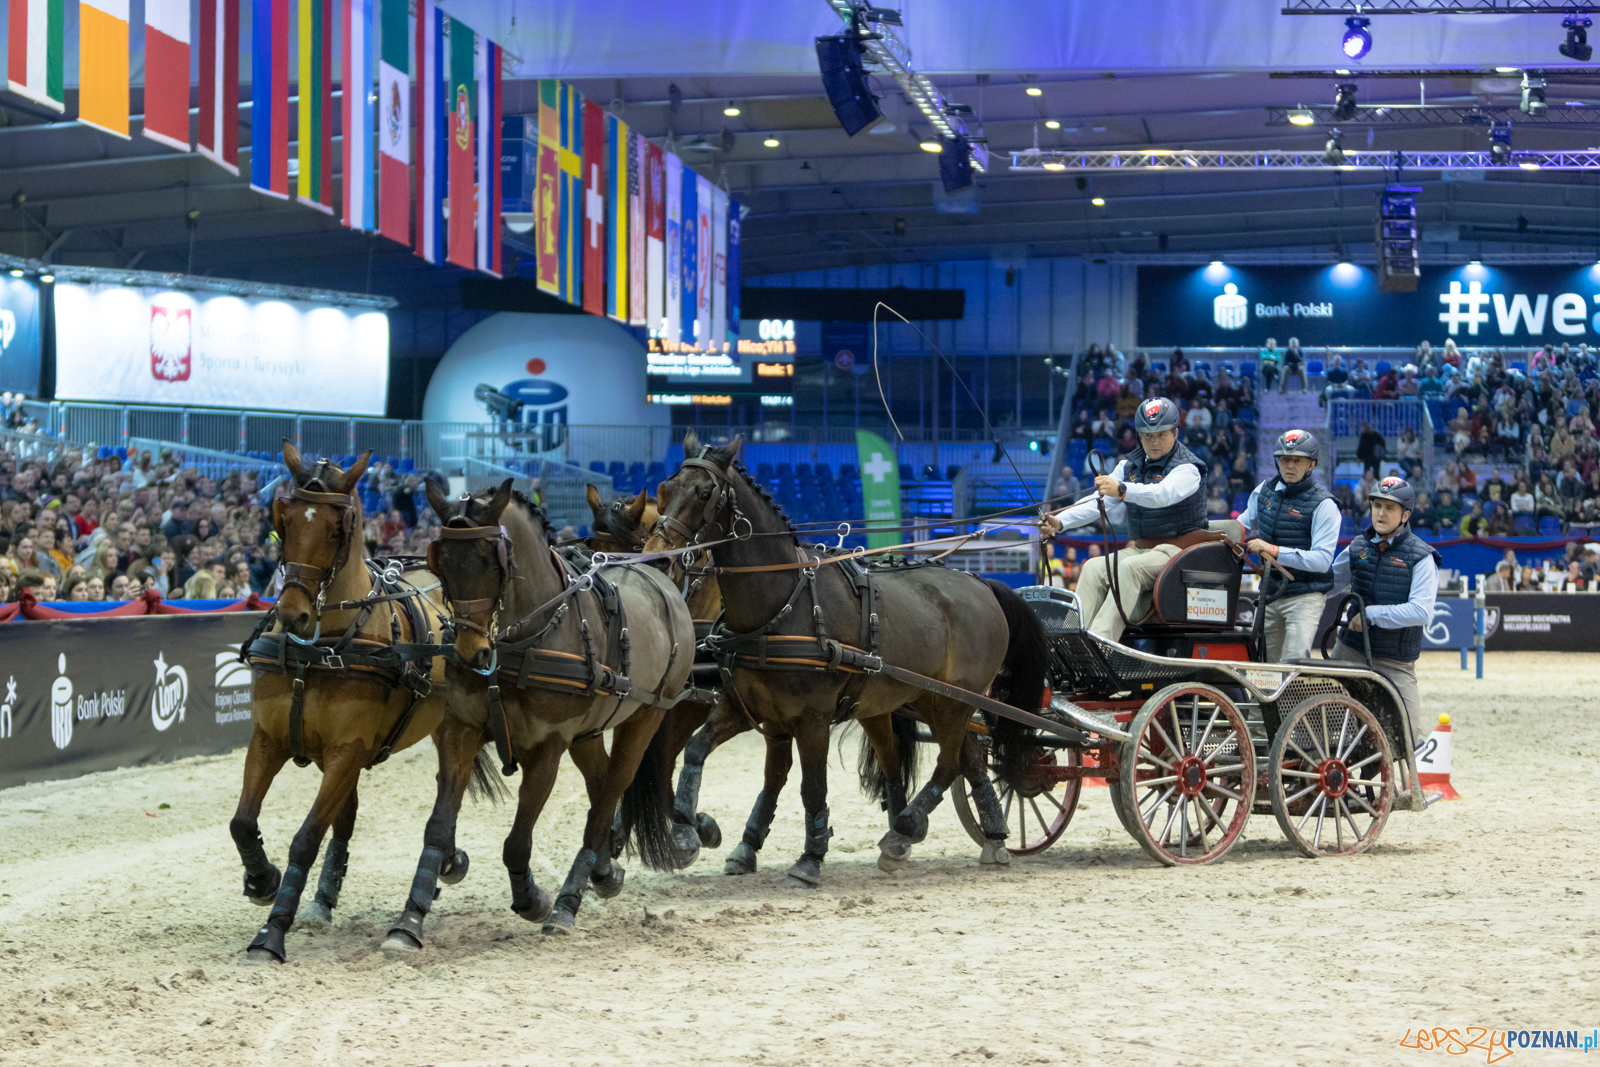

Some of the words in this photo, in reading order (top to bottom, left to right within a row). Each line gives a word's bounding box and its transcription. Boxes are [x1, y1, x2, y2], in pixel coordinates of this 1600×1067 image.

[1255, 303, 1290, 318] Bank
[1293, 302, 1333, 318] Polski
[759, 319, 795, 340] 004
[252, 355, 306, 378] Turystyki
[1187, 603, 1226, 617] equinox
[1254, 677, 1280, 687] equinox
[77, 691, 100, 721] Bank
[101, 689, 126, 718] Polski
[215, 691, 233, 711] Krajowy
[1420, 738, 1438, 764] 2
